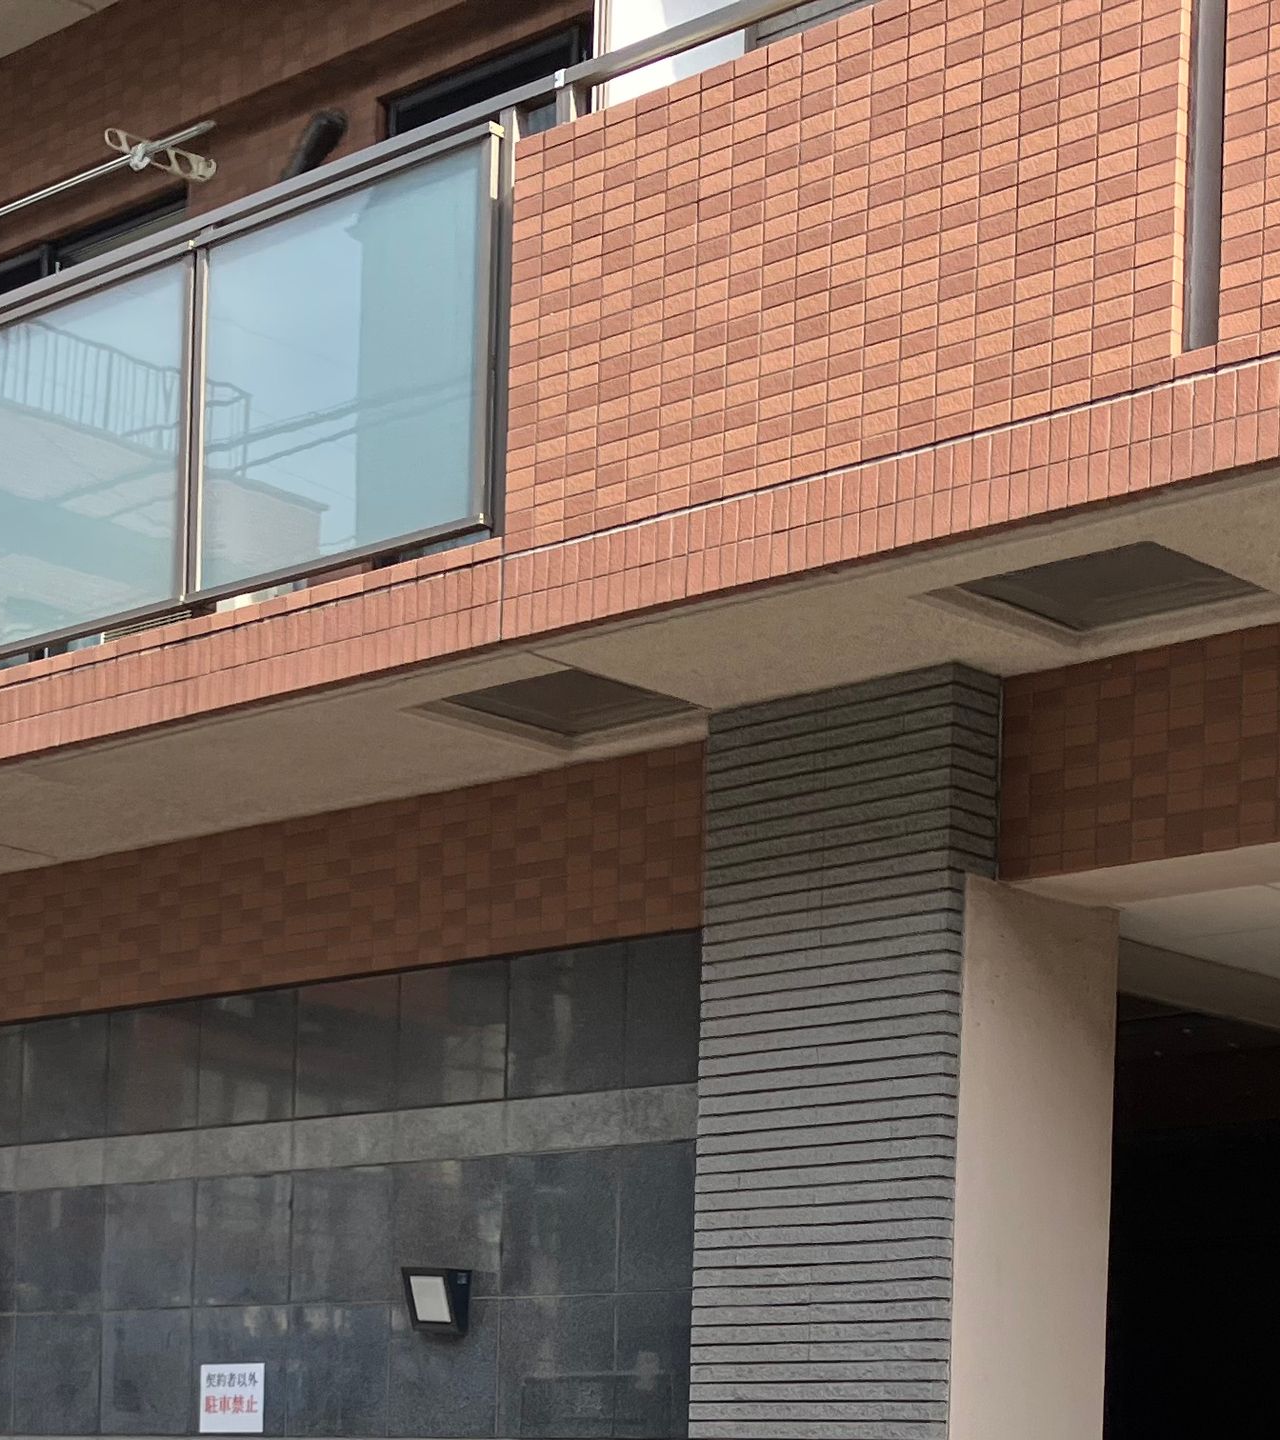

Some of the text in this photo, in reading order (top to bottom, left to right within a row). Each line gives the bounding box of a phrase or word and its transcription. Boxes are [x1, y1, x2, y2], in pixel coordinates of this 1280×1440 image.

[206, 1371, 259, 1388] 契約者以外
[205, 1393, 258, 1415] 駐車禁止
